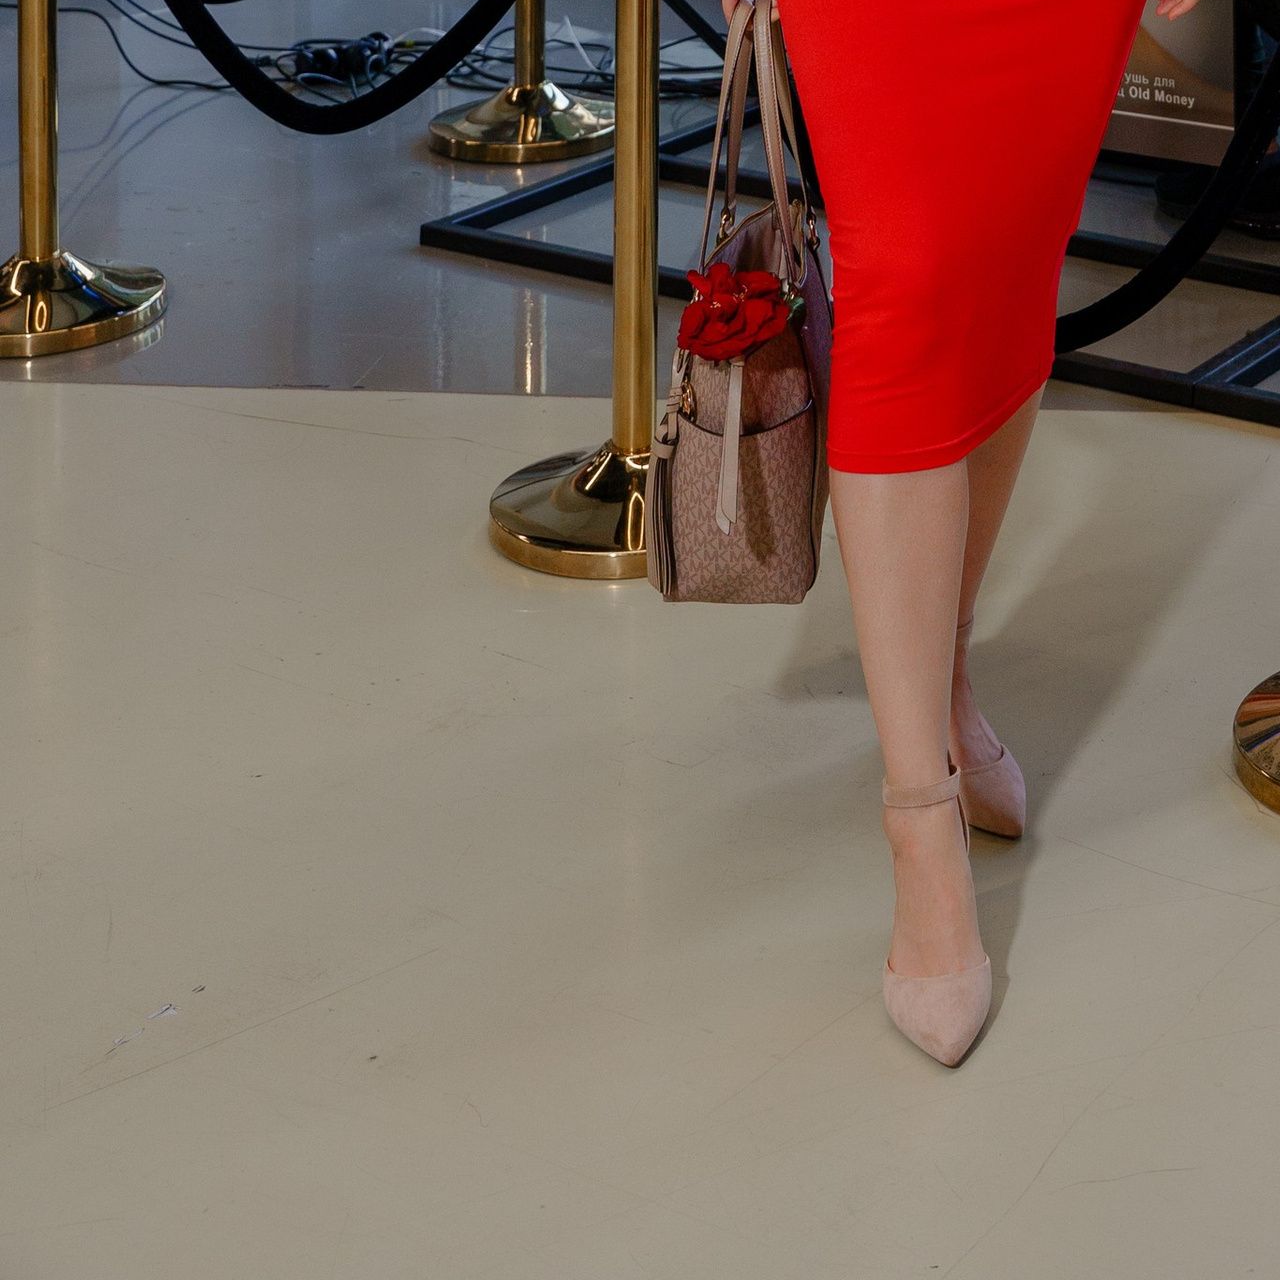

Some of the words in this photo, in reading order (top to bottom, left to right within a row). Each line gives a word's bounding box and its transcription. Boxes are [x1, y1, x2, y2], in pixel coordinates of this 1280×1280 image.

[1122, 72, 1150, 85] ушь
[1153, 76, 1176, 88] для
[1129, 86, 1150, 100] Old
[1154, 89, 1195, 109] Money
